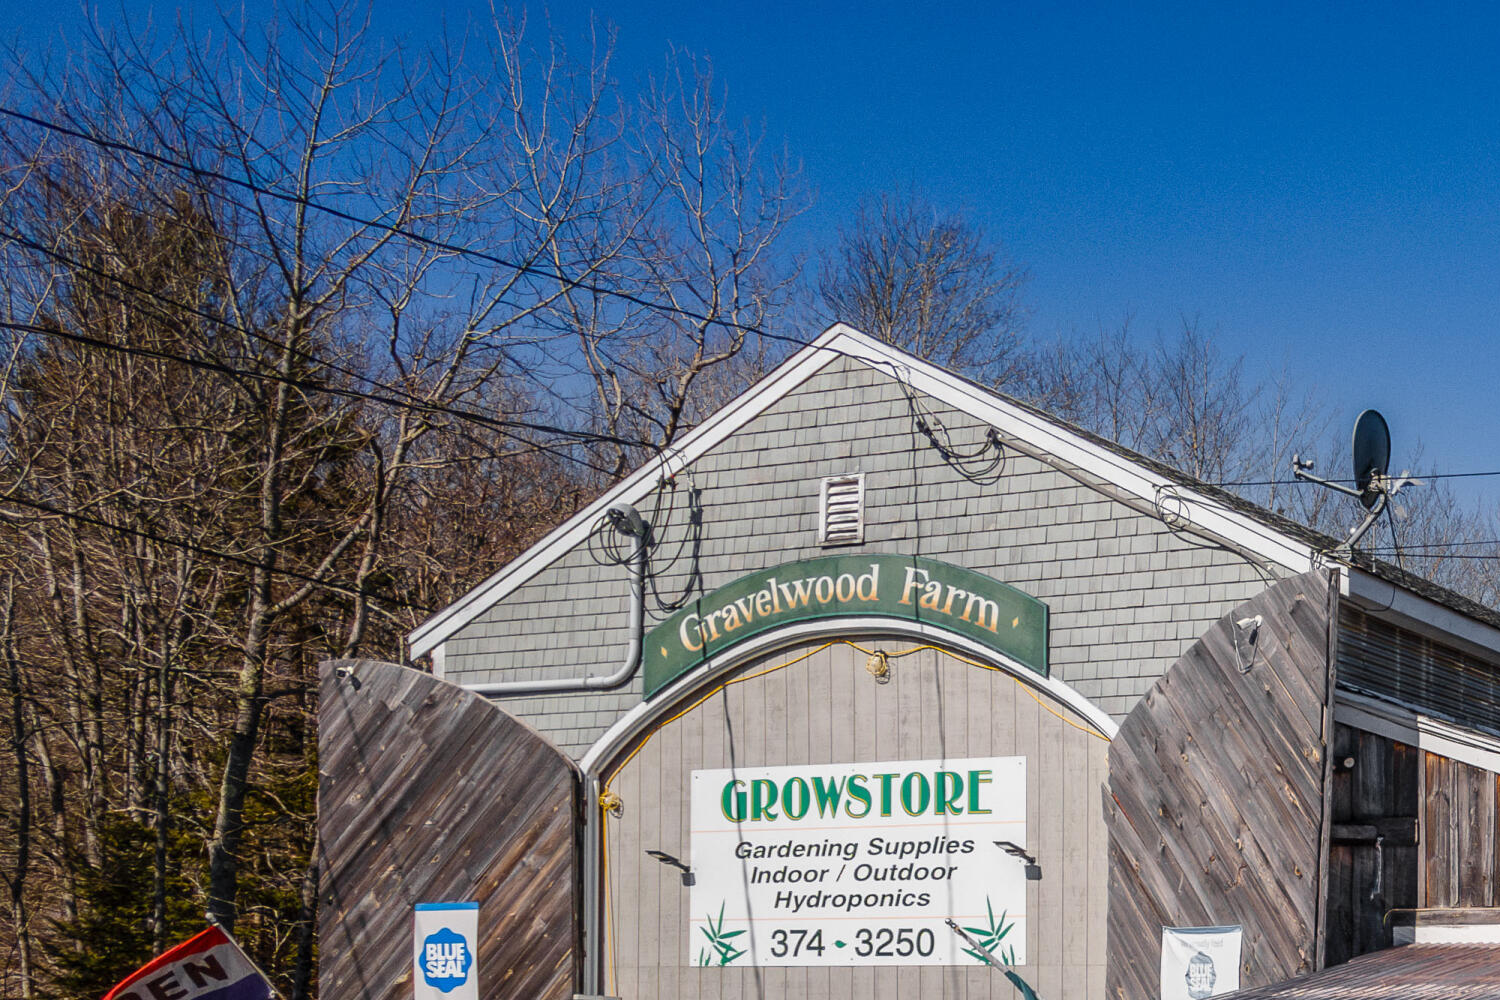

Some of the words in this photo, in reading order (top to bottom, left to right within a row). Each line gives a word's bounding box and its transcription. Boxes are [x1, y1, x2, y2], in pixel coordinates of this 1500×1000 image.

[680, 564, 880, 652] Gravelwood
[901, 566, 1000, 634] Farm
[721, 770, 993, 823] GROWSTORE
[735, 839, 858, 860] Gardening
[867, 836, 975, 859] Supplies
[751, 866, 829, 884] Indoor
[836, 864, 846, 882] /
[853, 863, 958, 882] Outdoor
[774, 889, 931, 912] Hydroponics
[426, 943, 465, 961] BLUE
[770, 929, 826, 957] 374
[854, 928, 935, 957] 3250
[425, 960, 466, 978] SEAL
